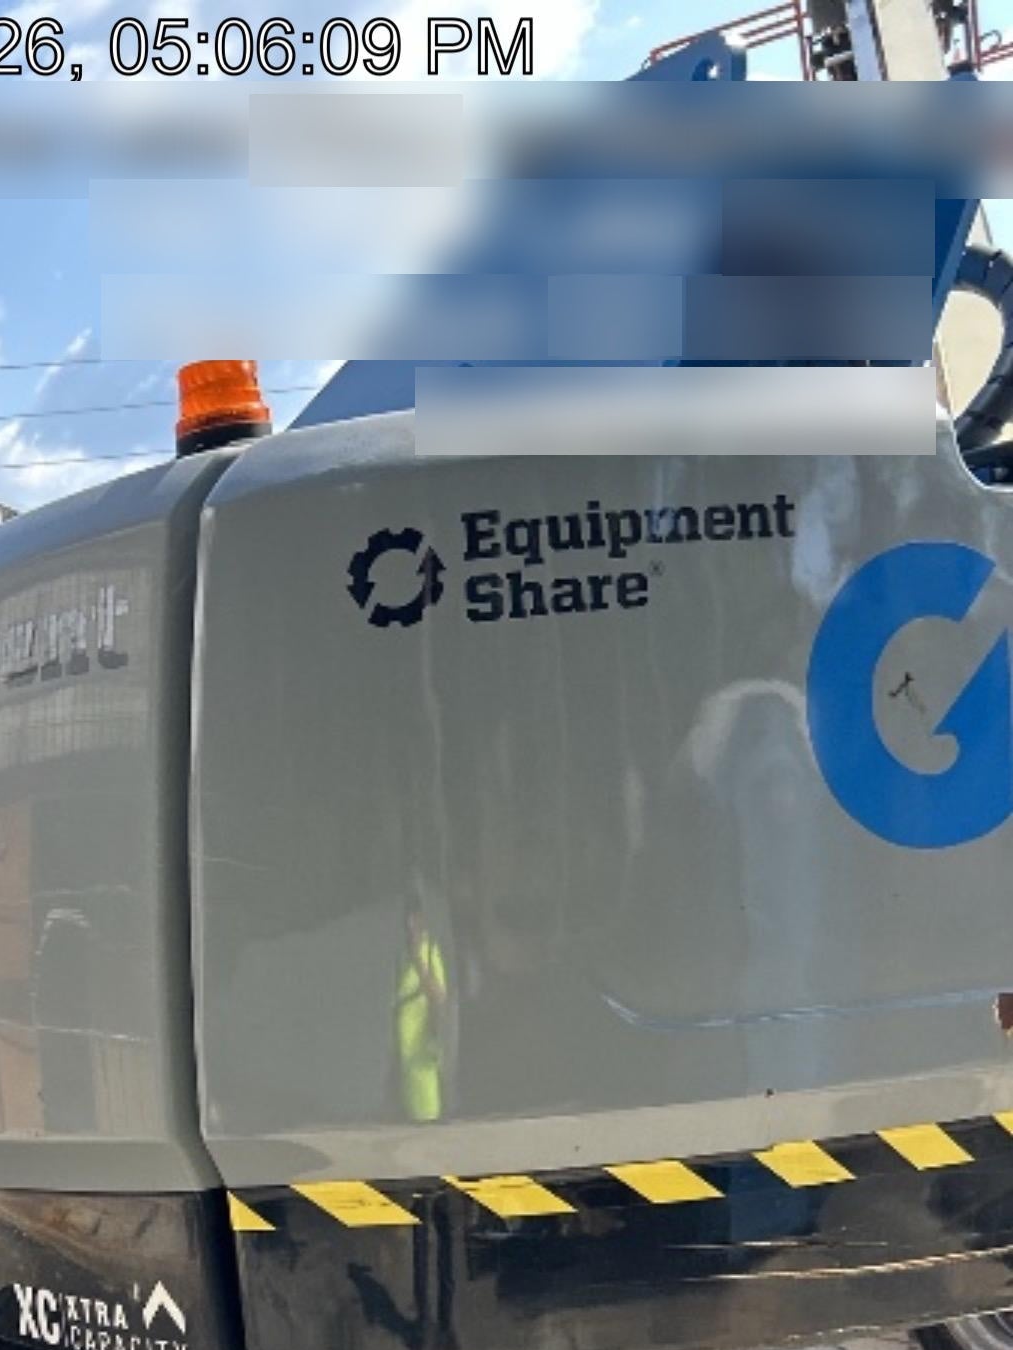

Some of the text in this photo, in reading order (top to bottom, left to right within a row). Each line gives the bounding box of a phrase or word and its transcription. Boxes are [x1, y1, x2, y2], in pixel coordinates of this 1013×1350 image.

[461, 494, 794, 565] Equipment
[13, 1283, 61, 1345] XC
[65, 1295, 129, 1330] XTRA
